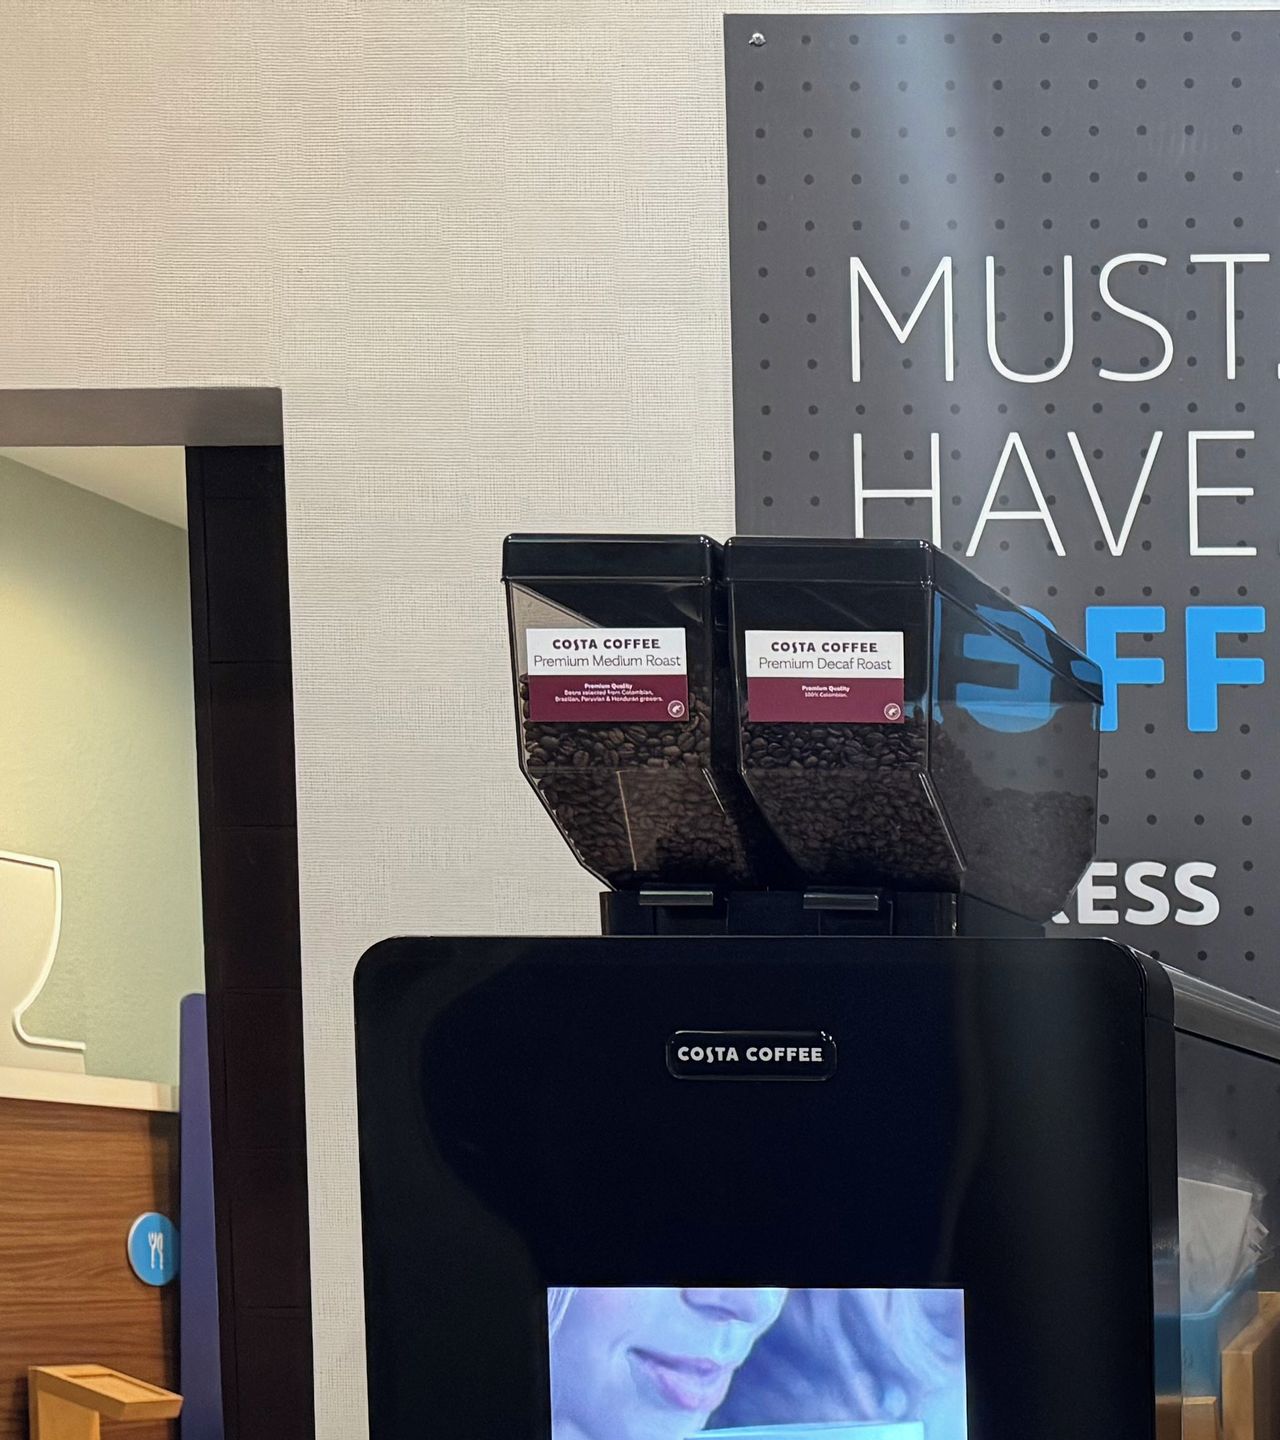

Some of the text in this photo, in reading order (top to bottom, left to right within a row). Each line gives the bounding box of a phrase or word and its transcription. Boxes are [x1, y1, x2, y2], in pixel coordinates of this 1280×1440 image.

[552, 638, 661, 650] COSTA COFFEE
[771, 642, 879, 653] COSTA COFFEE
[534, 655, 681, 667] Premium Medium Roast
[759, 657, 892, 670] Premium Decaf Roast
[1051, 861, 1220, 926] ESS
[677, 1046, 823, 1063] COSTA COFFEE
